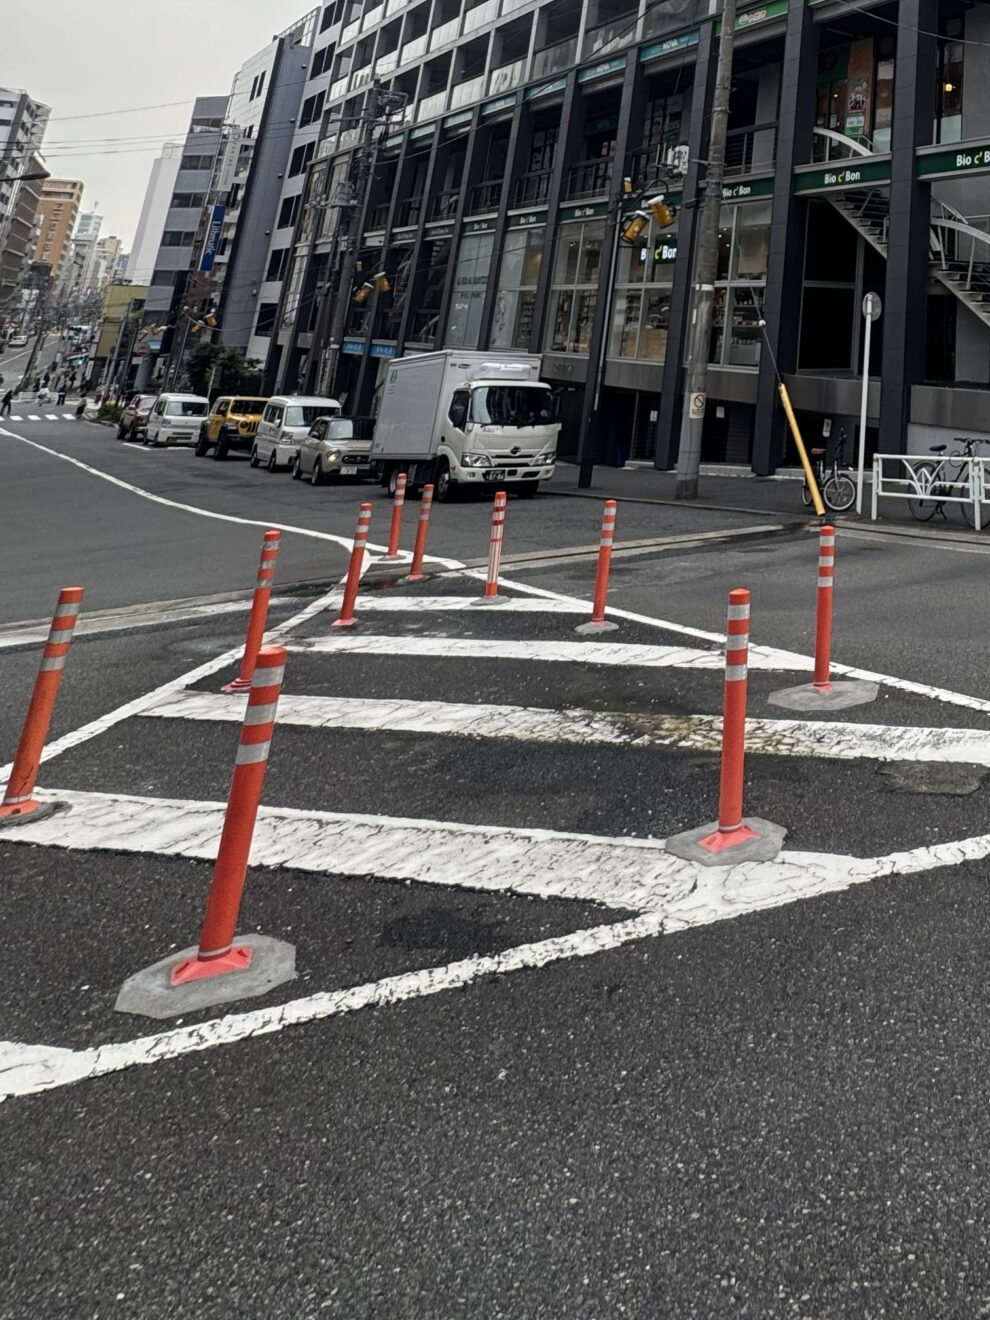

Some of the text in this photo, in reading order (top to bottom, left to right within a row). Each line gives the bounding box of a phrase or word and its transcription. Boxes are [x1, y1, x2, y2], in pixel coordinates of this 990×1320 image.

[956, 153, 972, 166] Bio
[824, 173, 836, 184] Bio
[845, 169, 861, 181] Bon
